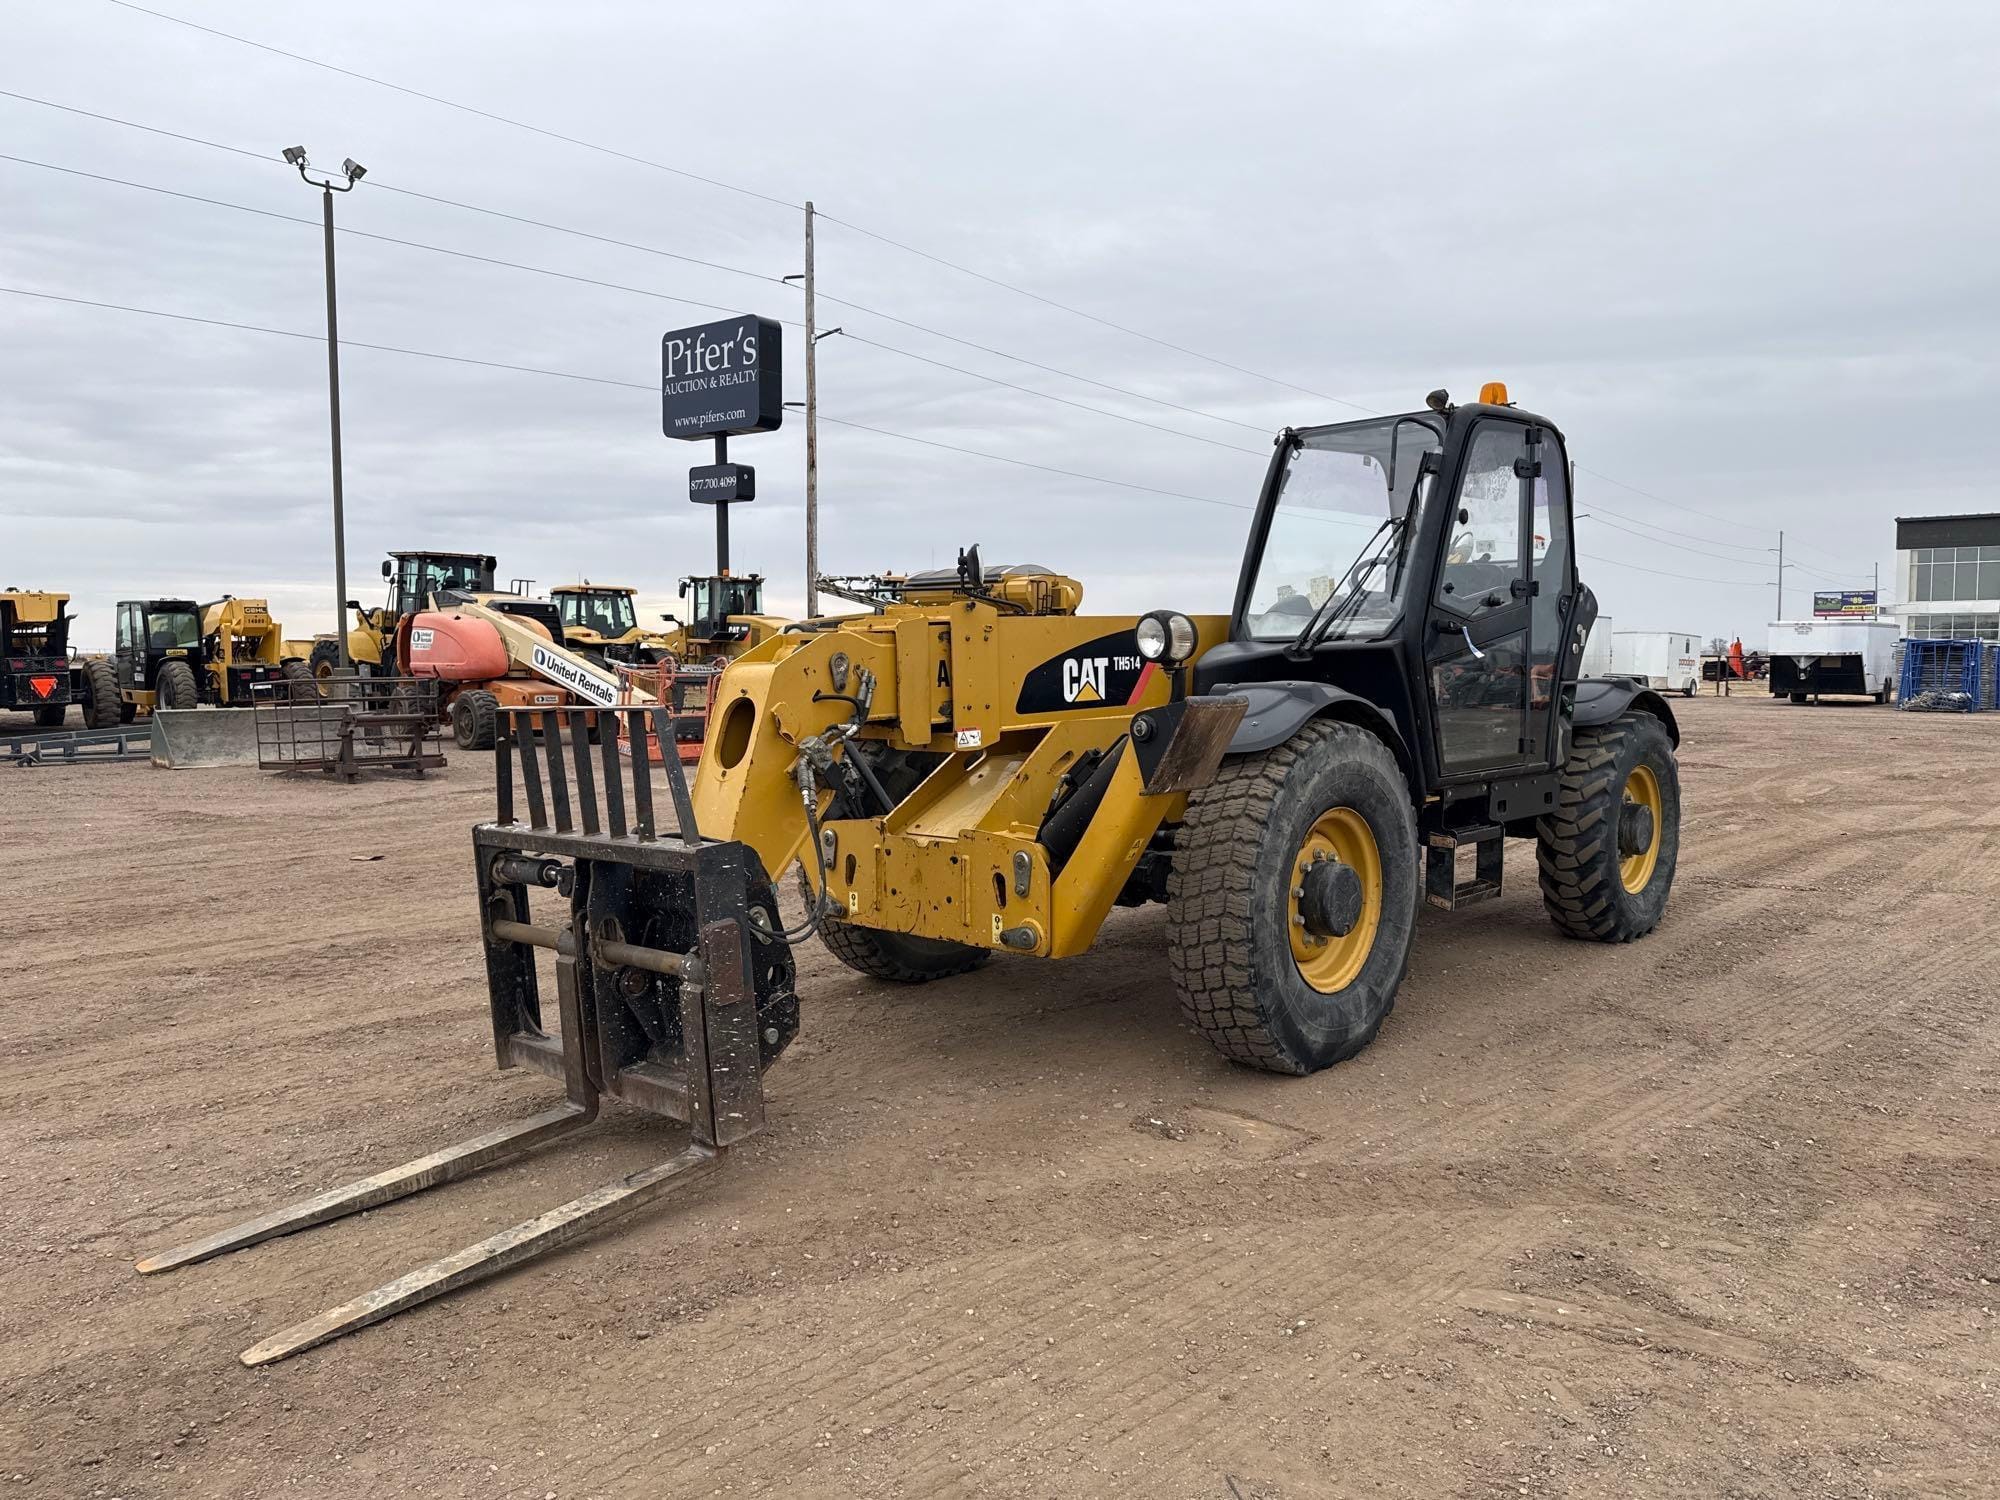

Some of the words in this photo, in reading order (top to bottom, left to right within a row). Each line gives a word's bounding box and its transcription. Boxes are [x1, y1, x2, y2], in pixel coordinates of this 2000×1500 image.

[665, 326, 757, 379] Pifer's
[664, 377, 708, 396] AUCTION
[709, 377, 718, 388] &
[719, 369, 758, 387] REALTY
[675, 409, 746, 428] www.pifers.com
[690, 476, 737, 490] 877.700.4099
[1113, 656, 1141, 671] TH514
[547, 656, 577, 683] United
[578, 674, 613, 703] Rentals
[1063, 658, 1109, 703] CAT
